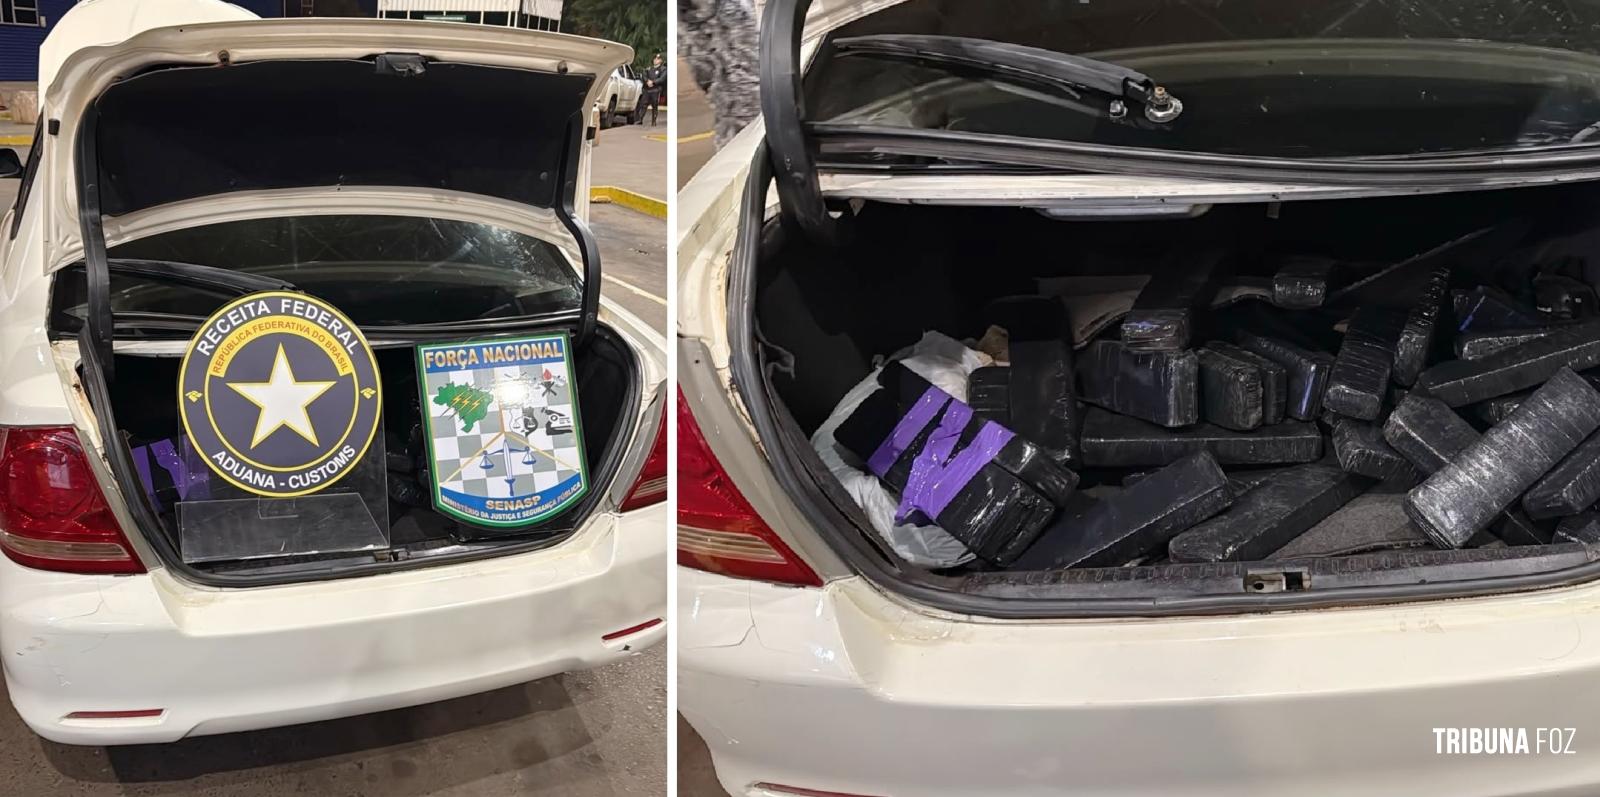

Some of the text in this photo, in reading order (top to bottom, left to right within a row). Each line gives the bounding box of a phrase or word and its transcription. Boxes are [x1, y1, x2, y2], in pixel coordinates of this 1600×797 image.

[197, 299, 360, 356] RECEITA FEDERAL
[212, 320, 348, 374] REPÚBLICA FEDERATIVA DO BRASIL
[425, 341, 563, 370] FORÇA NACIONAL
[212, 450, 276, 488] ADUANA
[288, 444, 356, 488] CUSTOMS
[441, 495, 480, 517] MINISTÉRIO
[490, 512, 516, 521] JUSTIÇA
[522, 499, 557, 518] SEGURANÇA
[556, 481, 581, 503] PÚBLICA
[486, 495, 542, 511] SENASP
